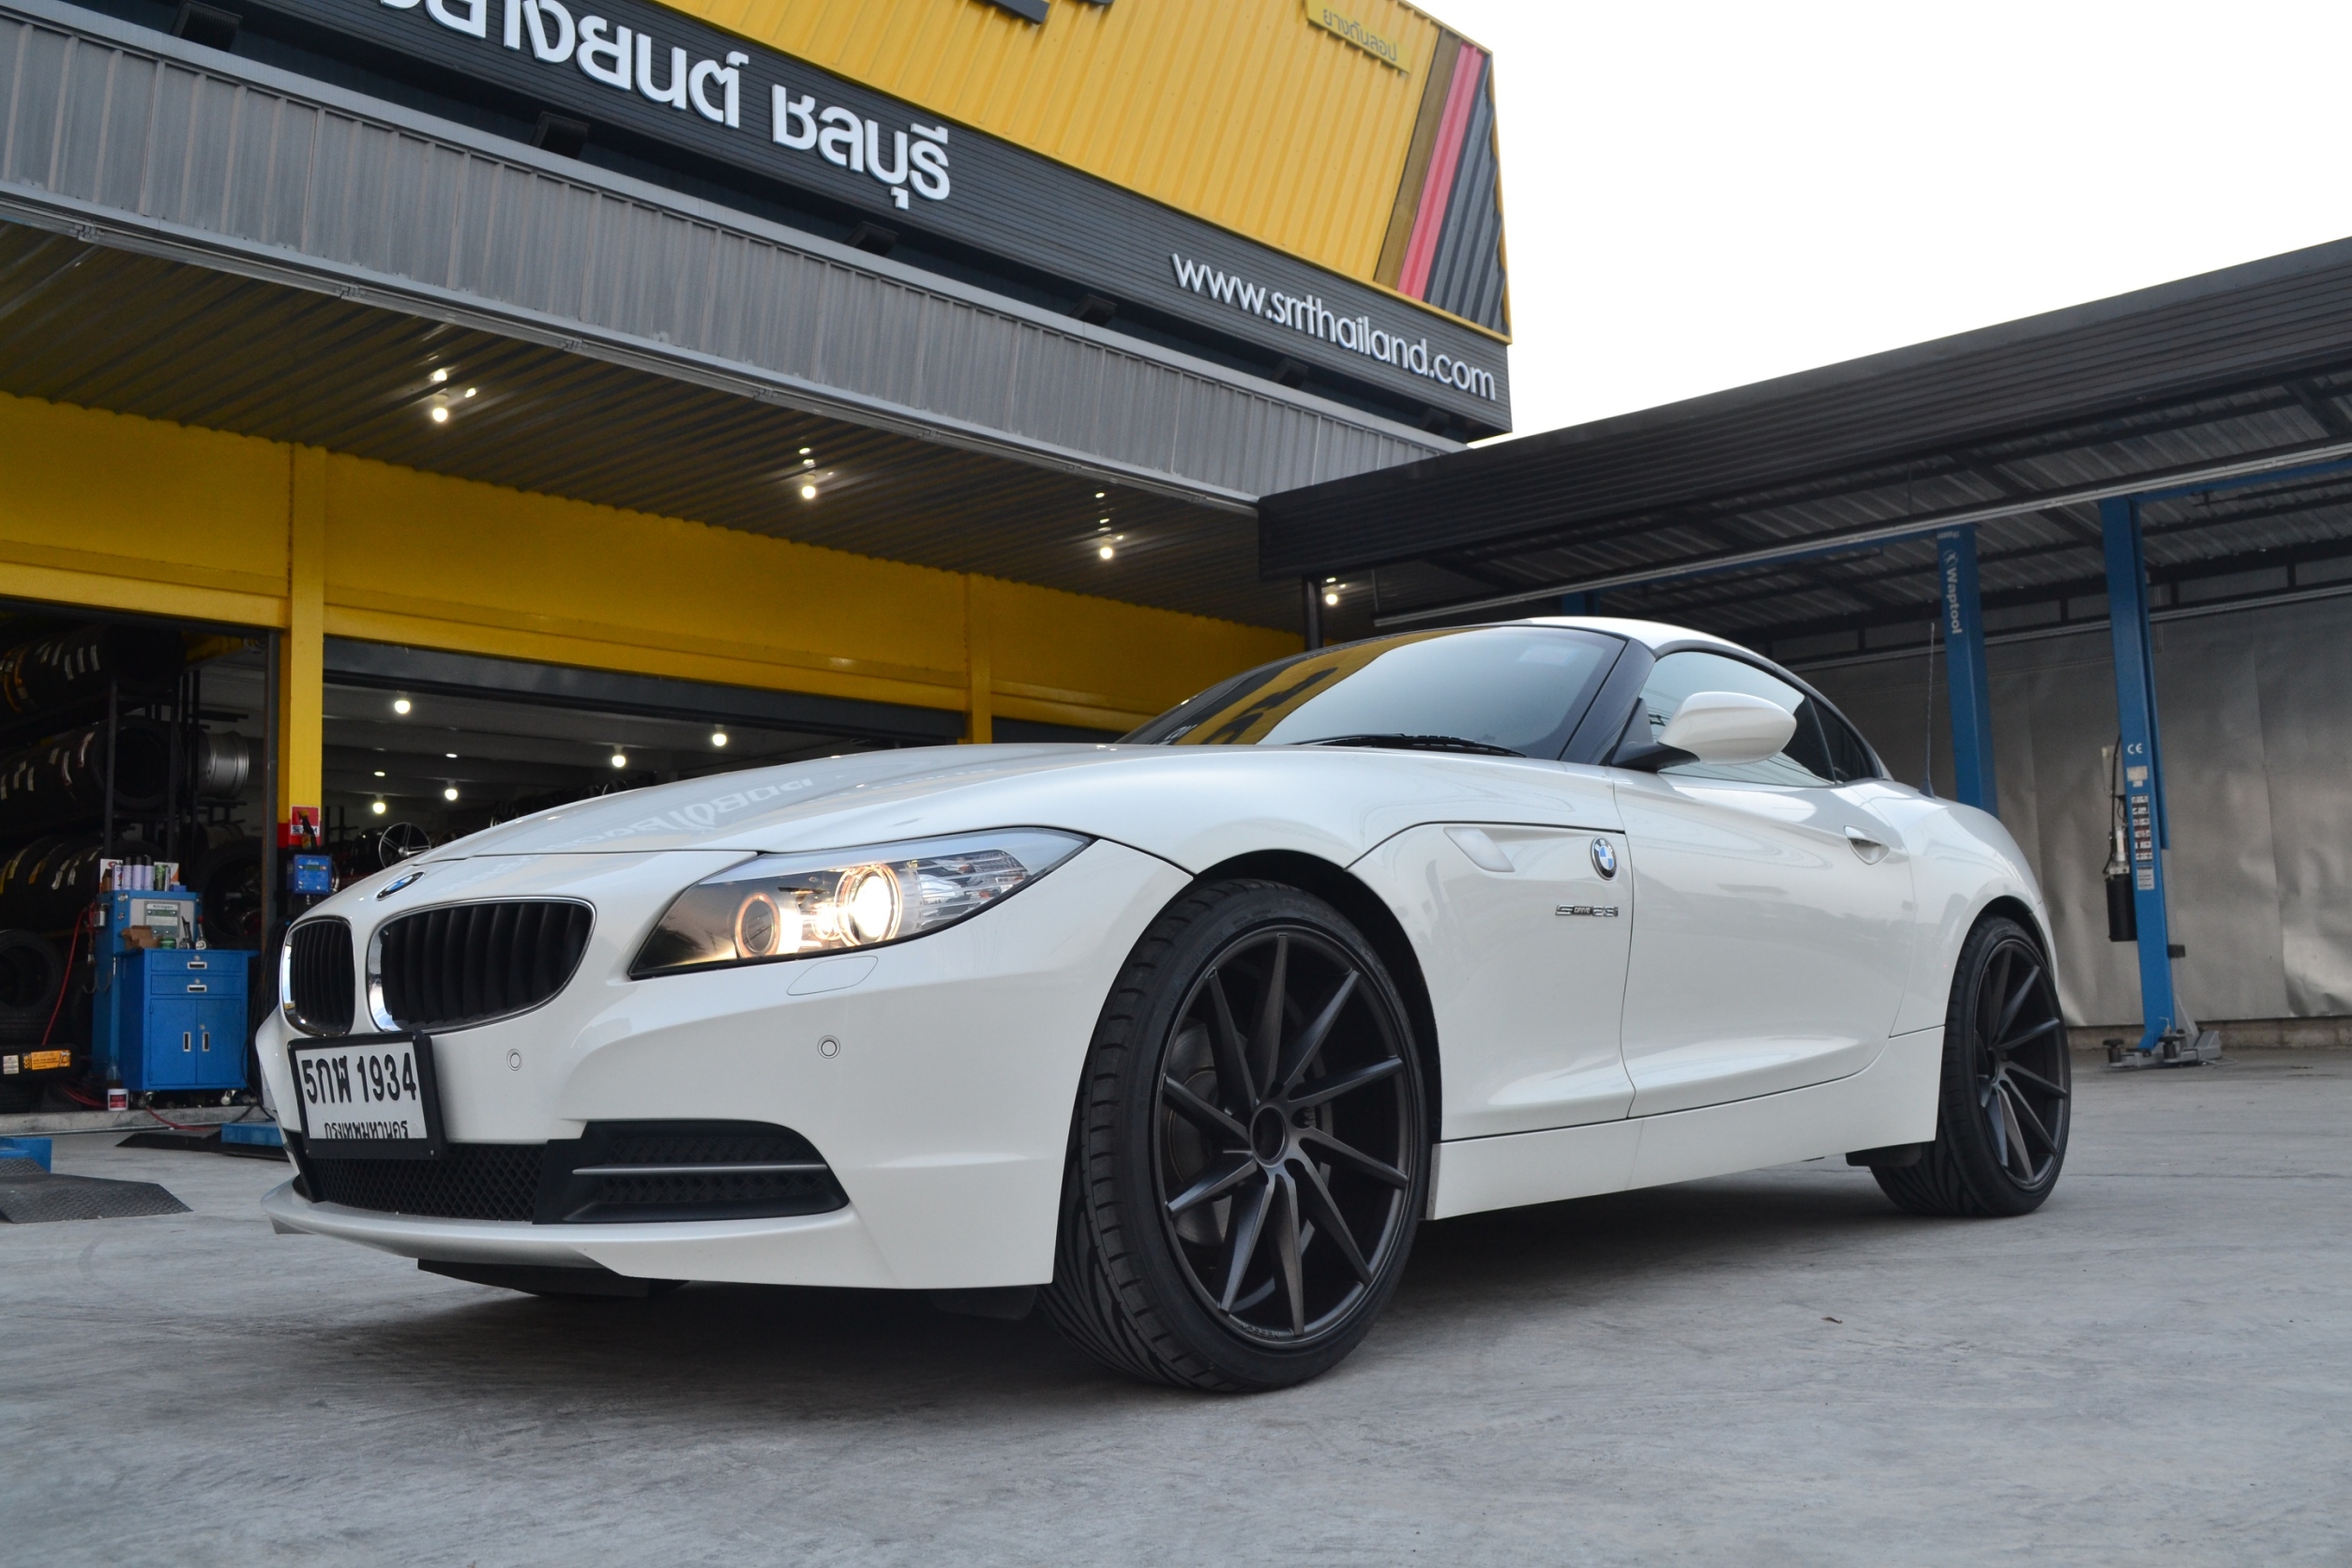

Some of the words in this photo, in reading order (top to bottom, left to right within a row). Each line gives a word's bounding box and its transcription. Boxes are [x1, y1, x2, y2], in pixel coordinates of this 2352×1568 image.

[1322, 8, 1397, 62] ยางดันลอป
[772, 83, 950, 209] ชลบุรี
[1171, 253, 1497, 401] www.srrthailand.com
[1946, 566, 1963, 635] Waptool
[356, 1052, 416, 1103] 1934
